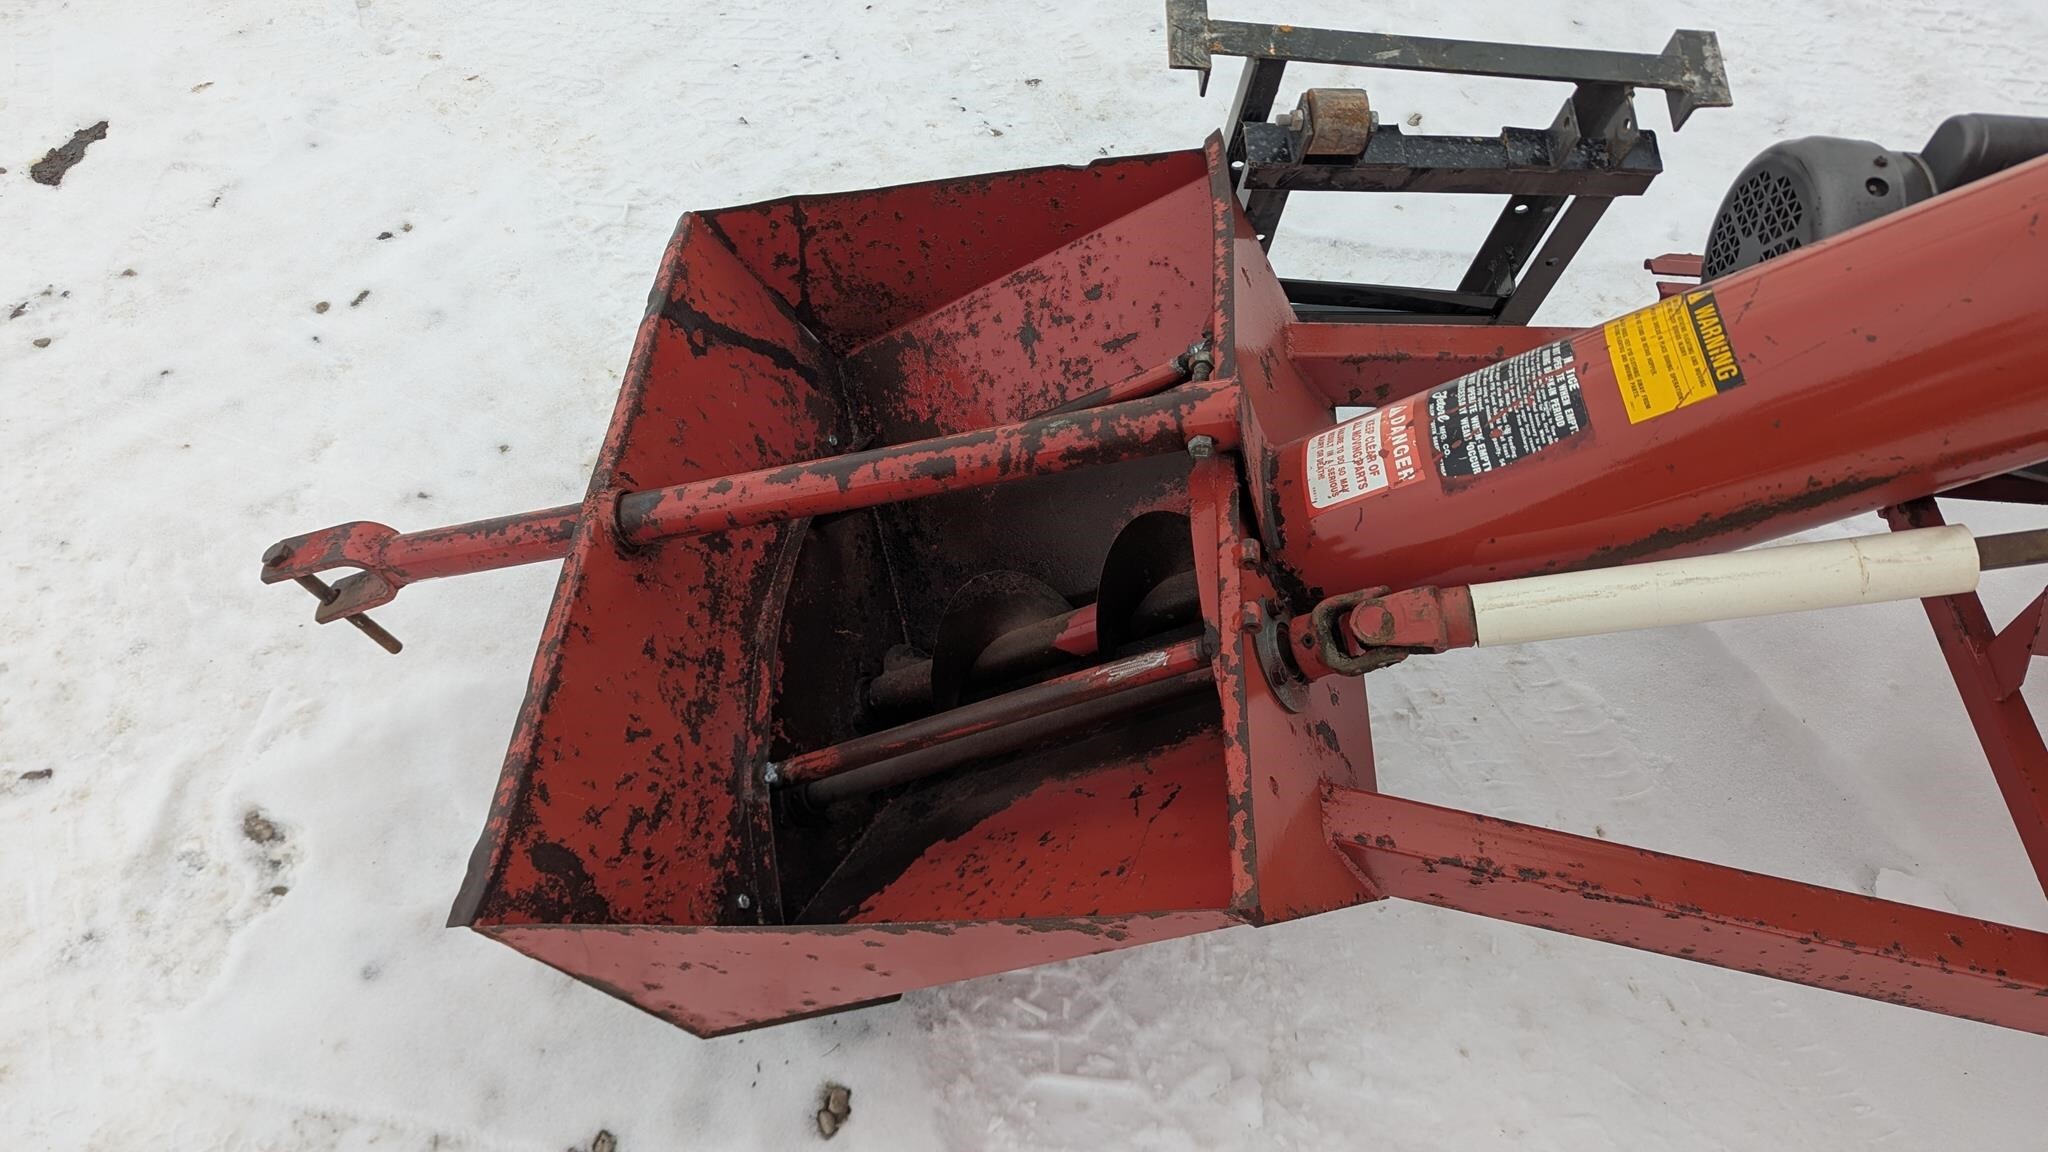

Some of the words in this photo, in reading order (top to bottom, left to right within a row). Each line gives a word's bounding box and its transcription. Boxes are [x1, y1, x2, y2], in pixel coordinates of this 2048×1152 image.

[1692, 302, 1739, 382] WARNING
[1562, 355, 1579, 392] NTICE
[1557, 383, 1571, 406] WHEN
[1549, 396, 1565, 428] PERIOD
[1364, 418, 1375, 435] KEEP
[1314, 448, 1325, 458] OR
[1335, 444, 1345, 454] TO
[1351, 428, 1363, 458] MOVING
[1364, 434, 1377, 463] CLEAR
[1389, 414, 1415, 482] DANGER
[1441, 442, 1451, 458] CO.
[1336, 454, 1345, 464] DO
[1337, 465, 1346, 476] SO
[1367, 463, 1380, 477] OF
[1476, 442, 1492, 473] EMPTY
[1325, 466, 1340, 498] SERIOUS
[1339, 477, 1350, 494] MAY
[1352, 458, 1368, 490] PARTS
